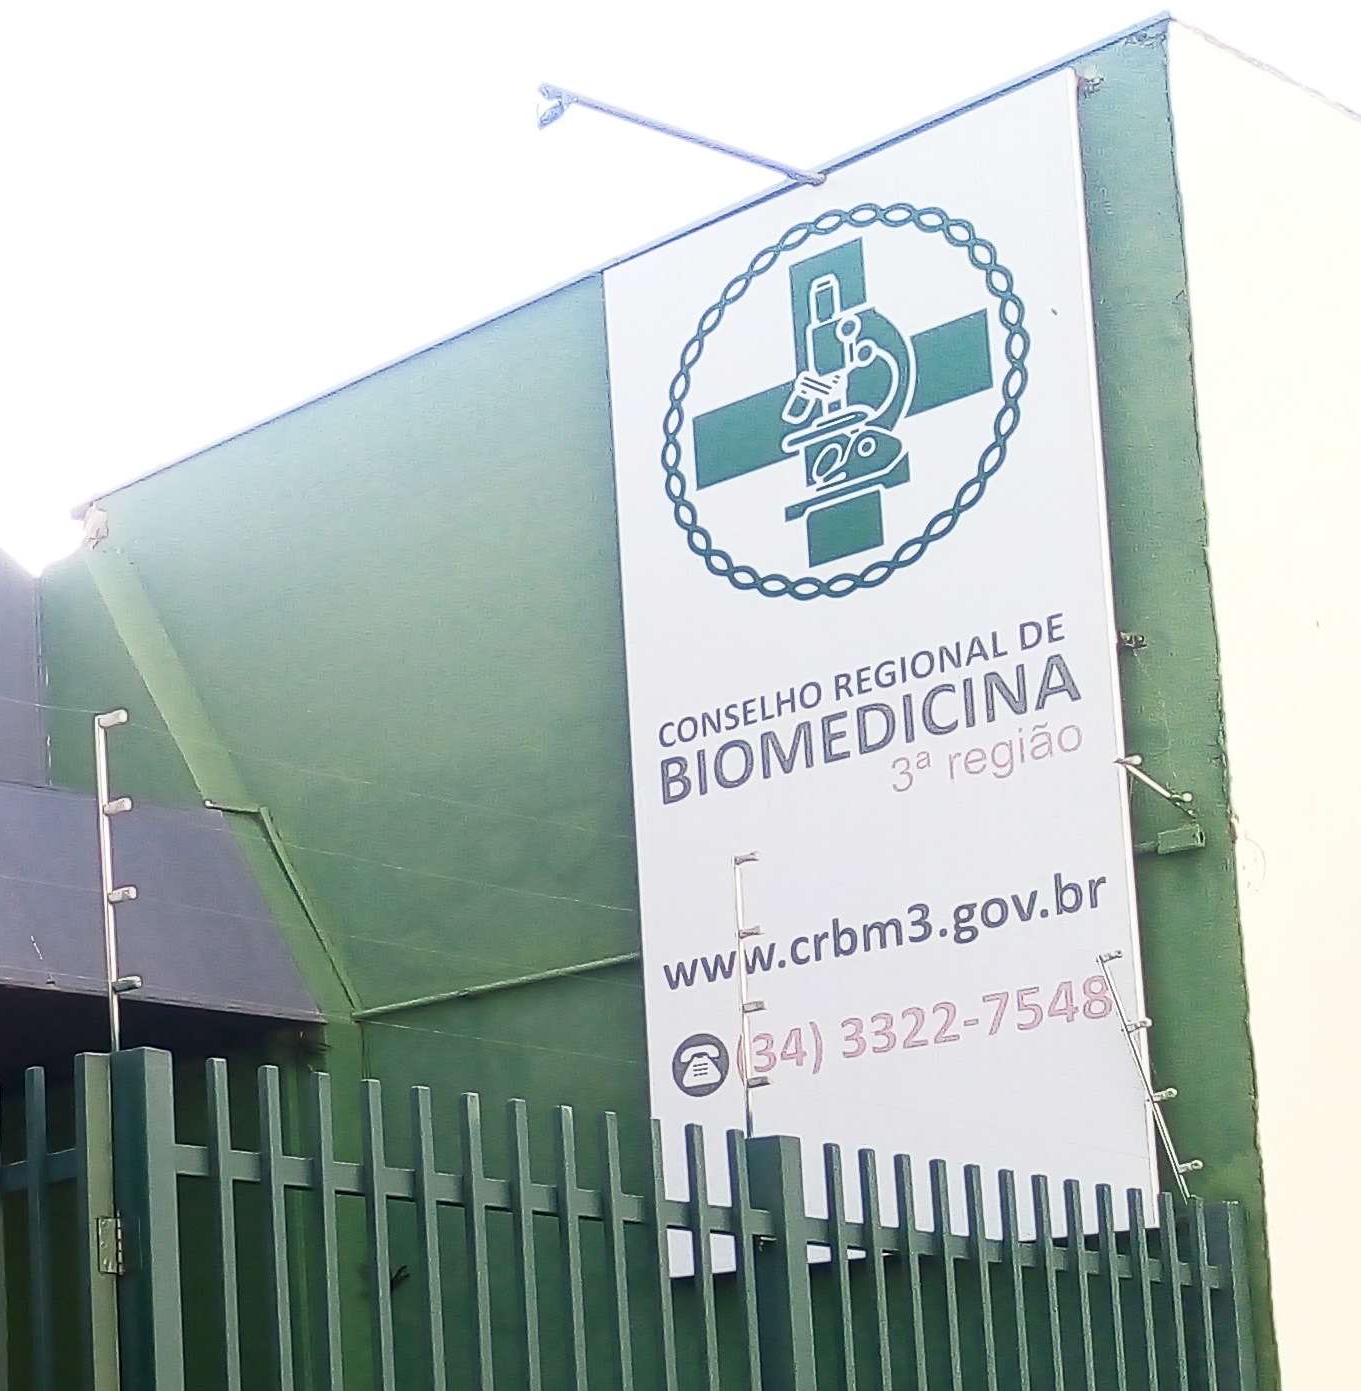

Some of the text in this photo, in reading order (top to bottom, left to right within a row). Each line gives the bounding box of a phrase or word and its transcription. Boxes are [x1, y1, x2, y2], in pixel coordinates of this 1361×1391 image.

[658, 613, 1066, 748] CONSELHO REGIONAL DE
[660, 653, 1082, 805] BIOMEDICINA
[948, 721, 1084, 781] região
[663, 872, 1107, 990] www.crbm3.gov.br
[735, 974, 1114, 1086] (34) 3322-7548
